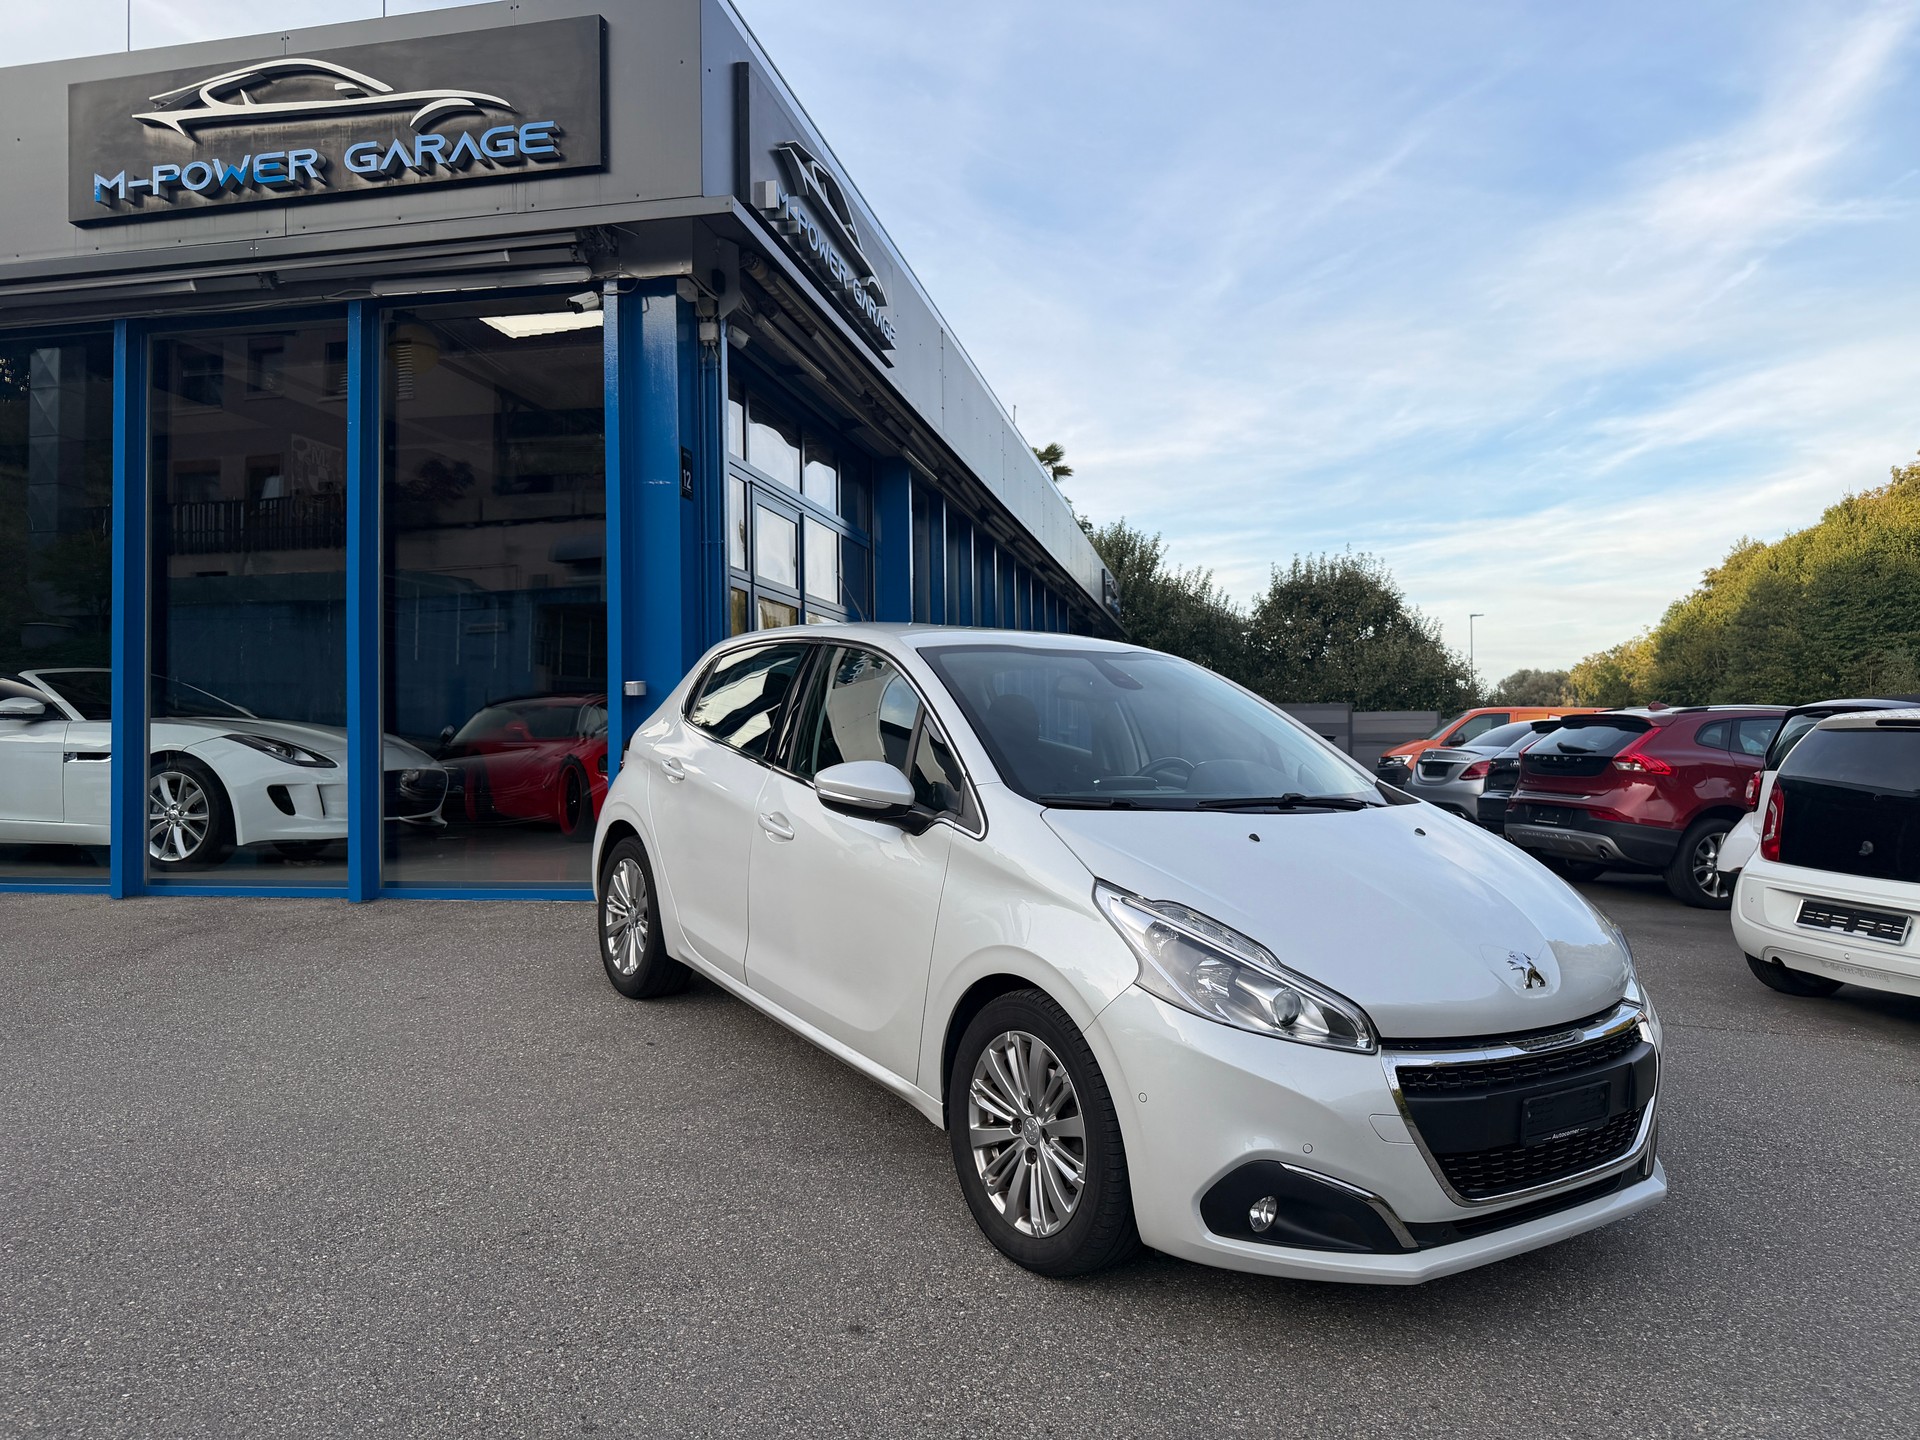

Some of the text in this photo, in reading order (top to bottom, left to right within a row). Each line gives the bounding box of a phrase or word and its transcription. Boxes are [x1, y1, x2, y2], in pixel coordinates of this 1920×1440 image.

[94, 120, 556, 203] M-POWER GARAGE
[775, 183, 897, 350] M-POWER GARAGE
[683, 469, 692, 490] 12
